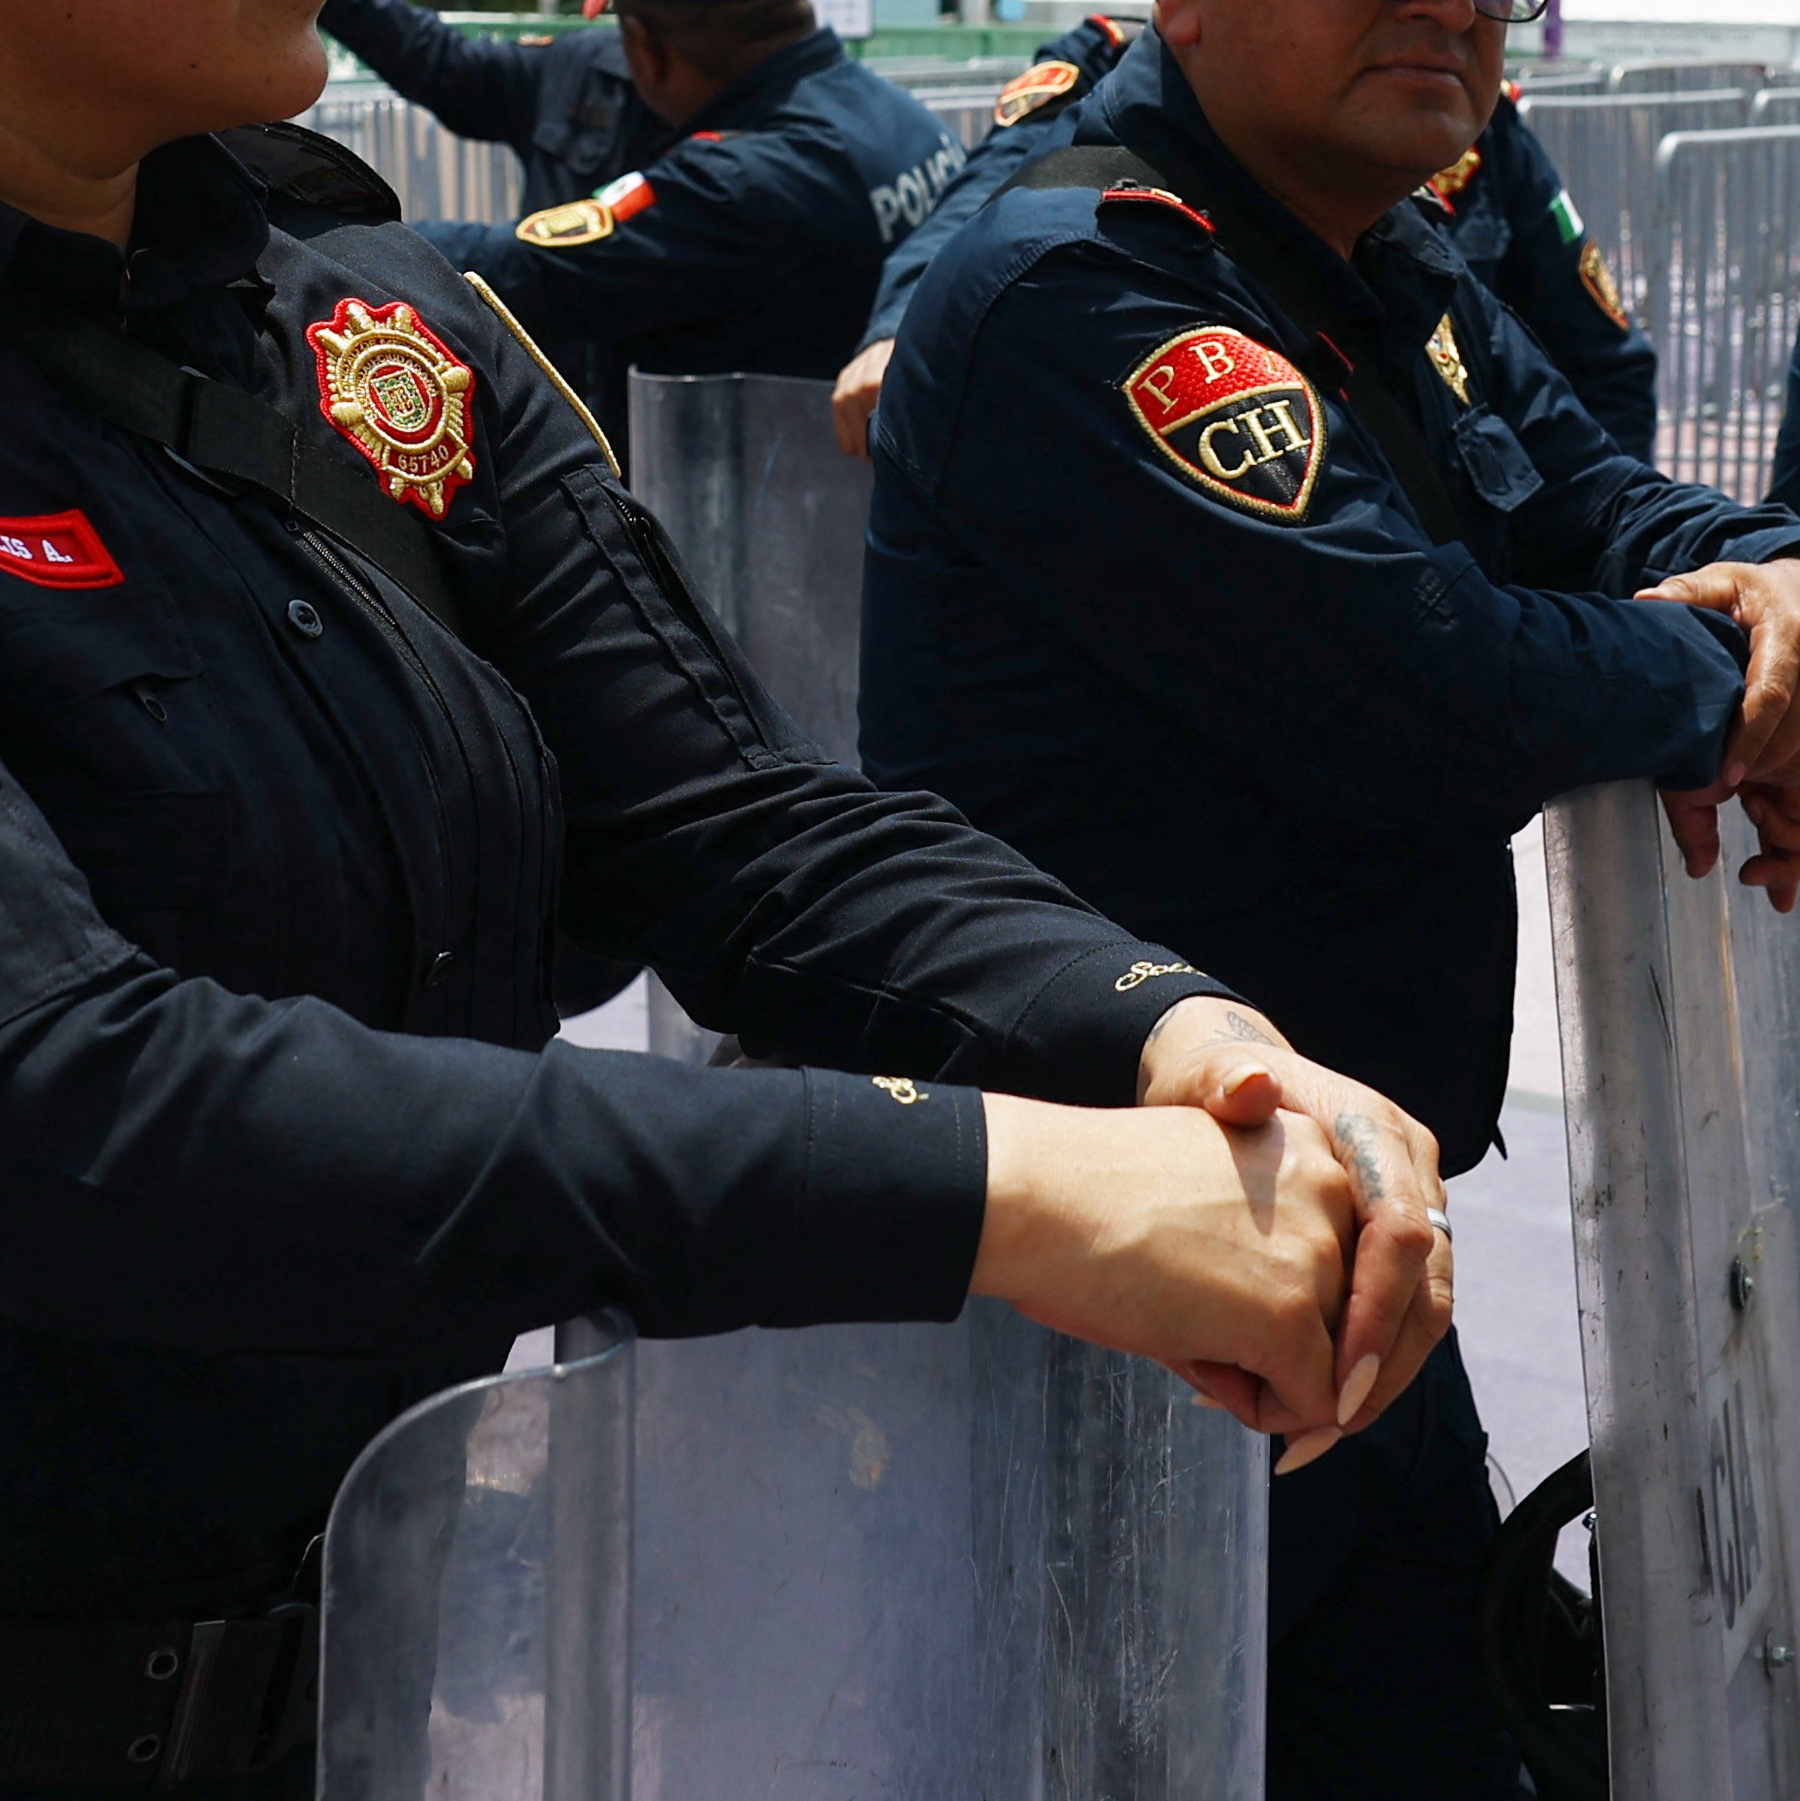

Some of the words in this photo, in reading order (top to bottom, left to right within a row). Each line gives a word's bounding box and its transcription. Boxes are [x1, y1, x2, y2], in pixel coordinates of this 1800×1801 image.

[1198, 399, 1312, 480] CH
[397, 443, 450, 474] 65740
[41, 538, 74, 563] A.
